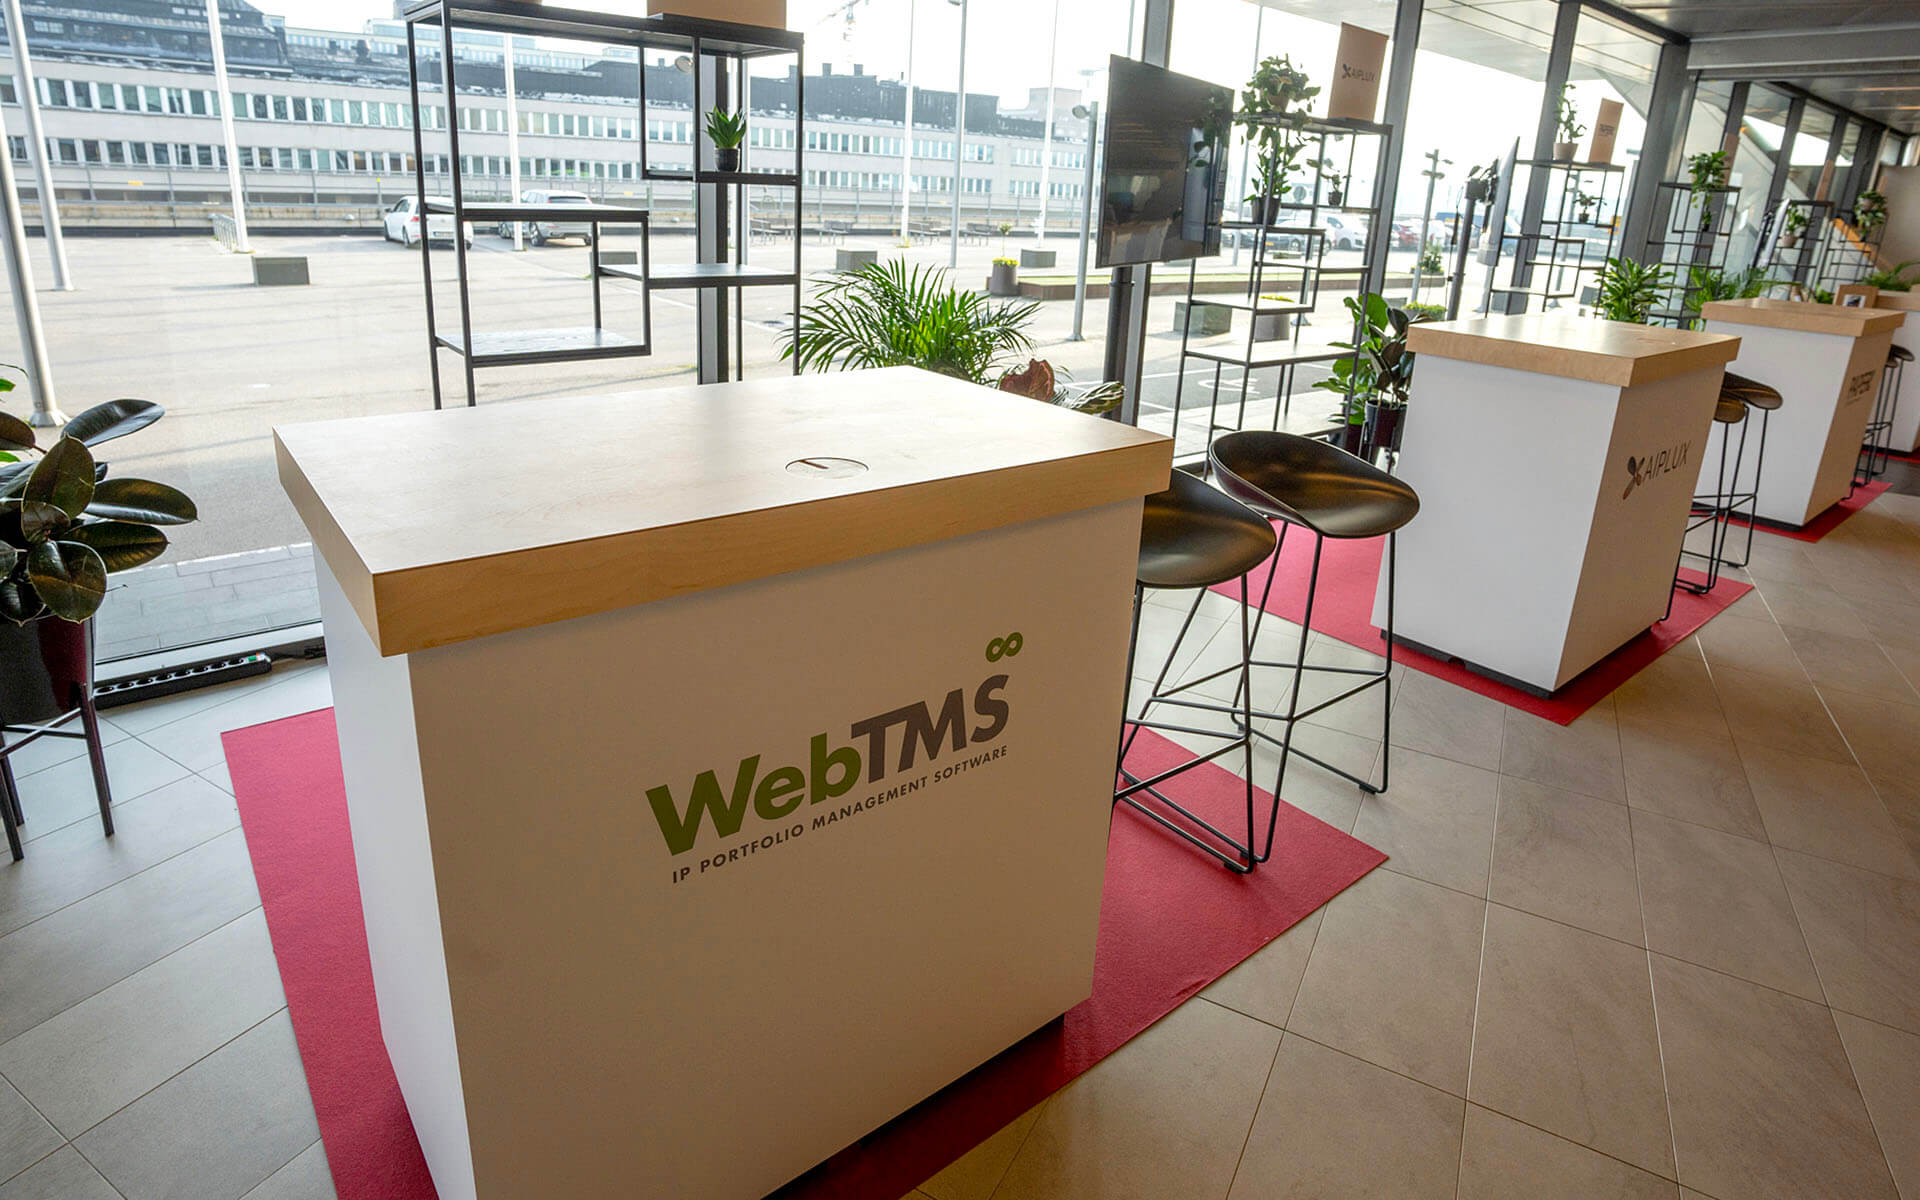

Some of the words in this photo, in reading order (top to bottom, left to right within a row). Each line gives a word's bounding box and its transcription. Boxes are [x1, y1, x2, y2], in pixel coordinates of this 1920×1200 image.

[1642, 439, 1692, 486] AIPLUX
[645, 674, 1009, 856] WebTMS
[672, 866, 691, 884] IP
[700, 824, 804, 873] PORTFOLIO
[812, 776, 928, 831] MANAGEMENT
[934, 745, 1008, 783] SOFTWARE
